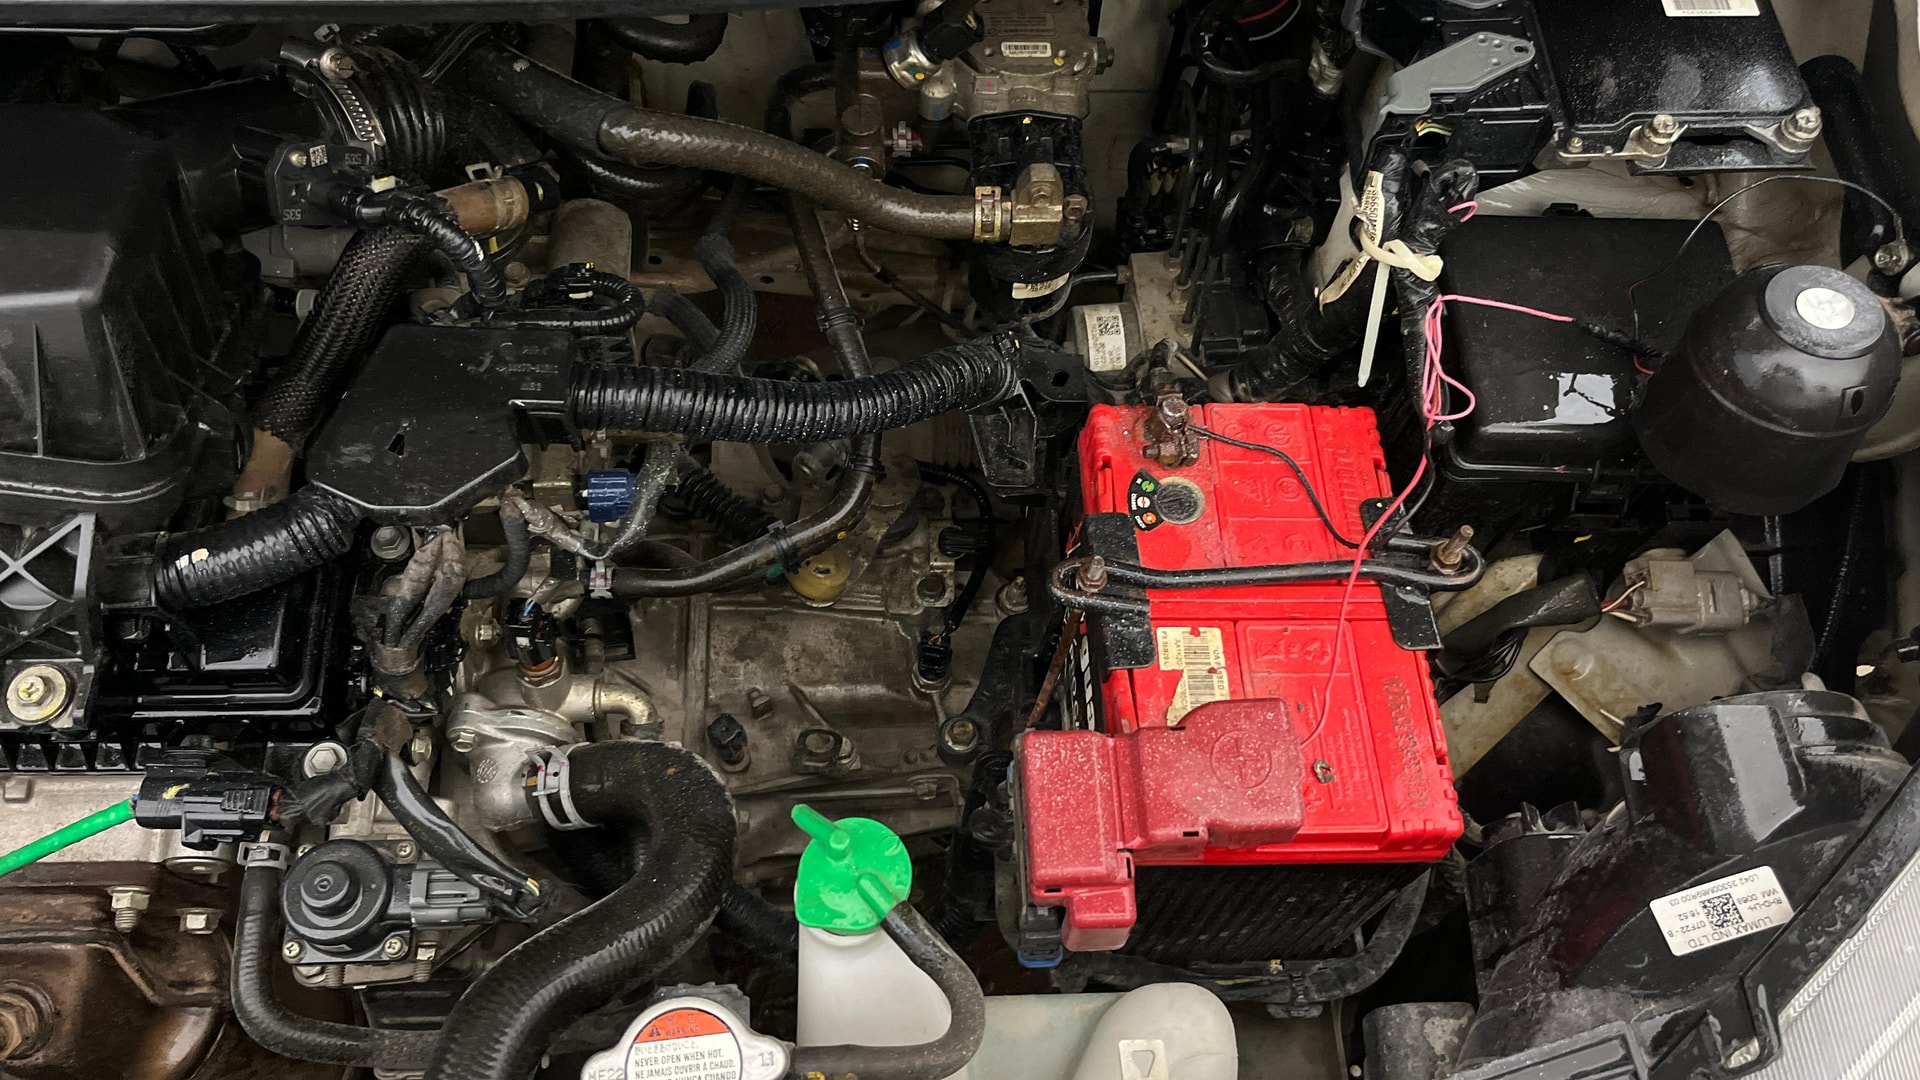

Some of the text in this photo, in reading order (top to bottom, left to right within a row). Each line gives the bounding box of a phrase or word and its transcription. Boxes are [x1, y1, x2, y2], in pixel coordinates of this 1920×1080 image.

[1687, 916, 1773, 949] LUMAX IND LTD
[665, 1025, 700, 1036] WARNING
[635, 1048, 724, 1068] NEVER OPEN WHEN HOT.
[635, 1069, 645, 1080] NE
[646, 1066, 672, 1079] JAMAIS
[674, 1063, 701, 1075] OUVRIR
[709, 1059, 736, 1071] CHAUD.
